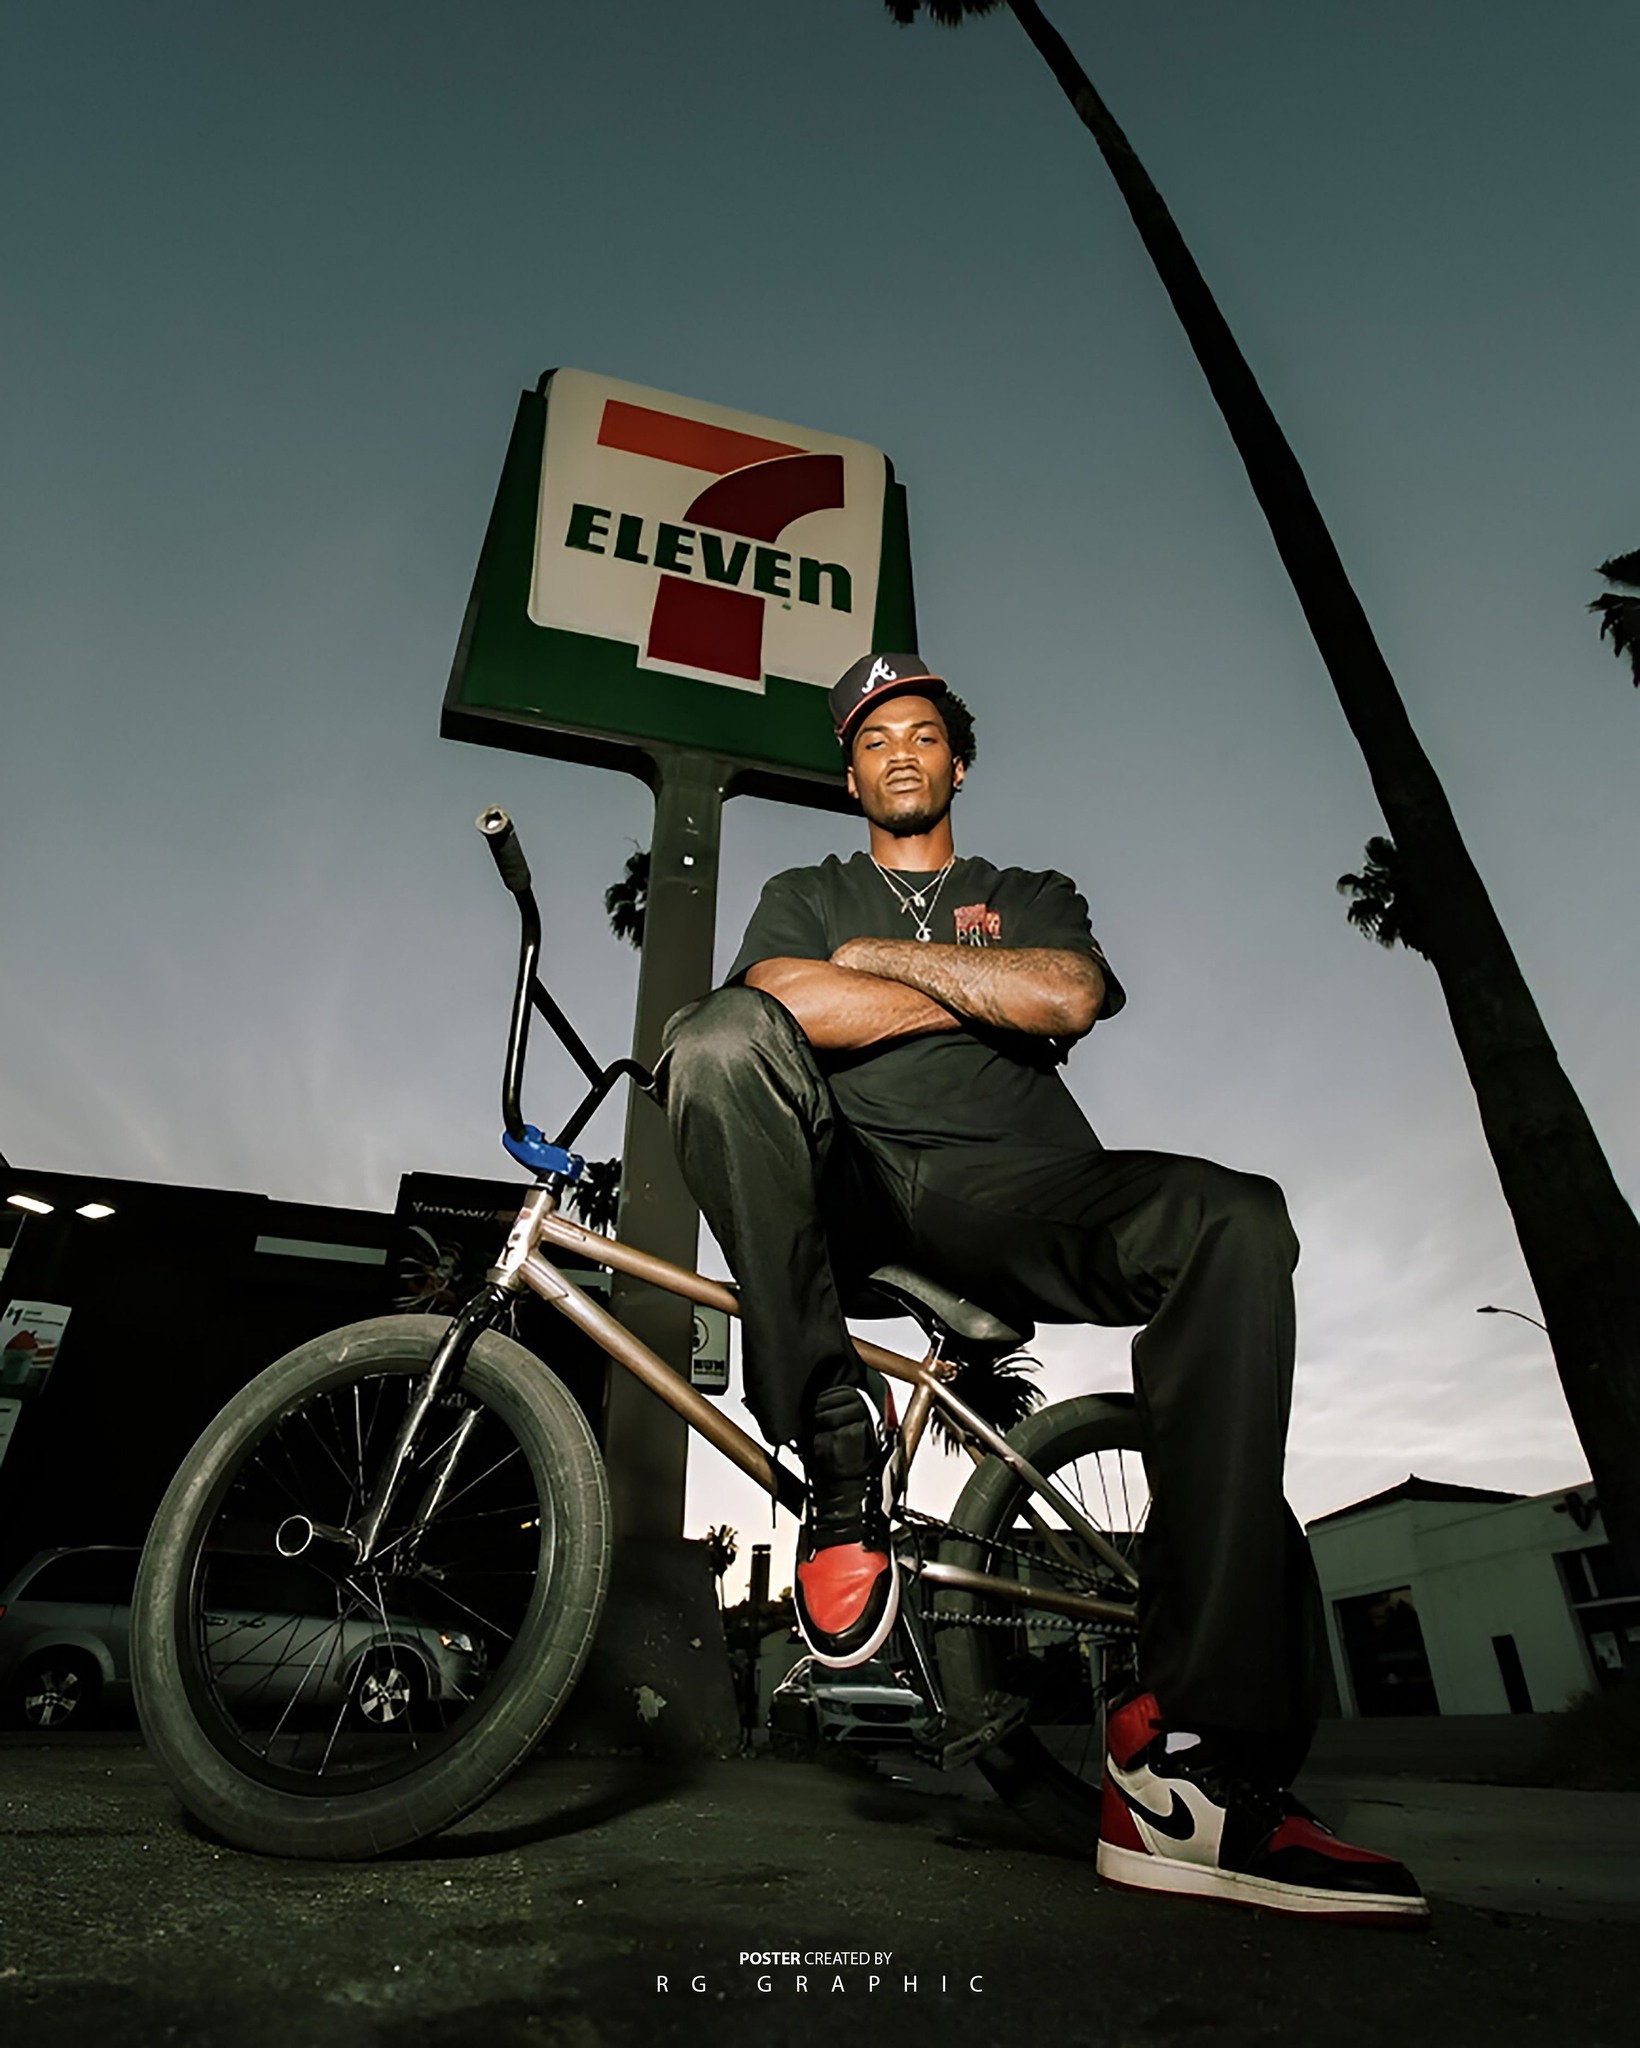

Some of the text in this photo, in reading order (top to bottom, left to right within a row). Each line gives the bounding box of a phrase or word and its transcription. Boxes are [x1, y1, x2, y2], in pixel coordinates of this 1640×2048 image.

[565, 503, 853, 613] ELEVEn
[597, 399, 845, 681] 7
[861, 656, 897, 694] A
